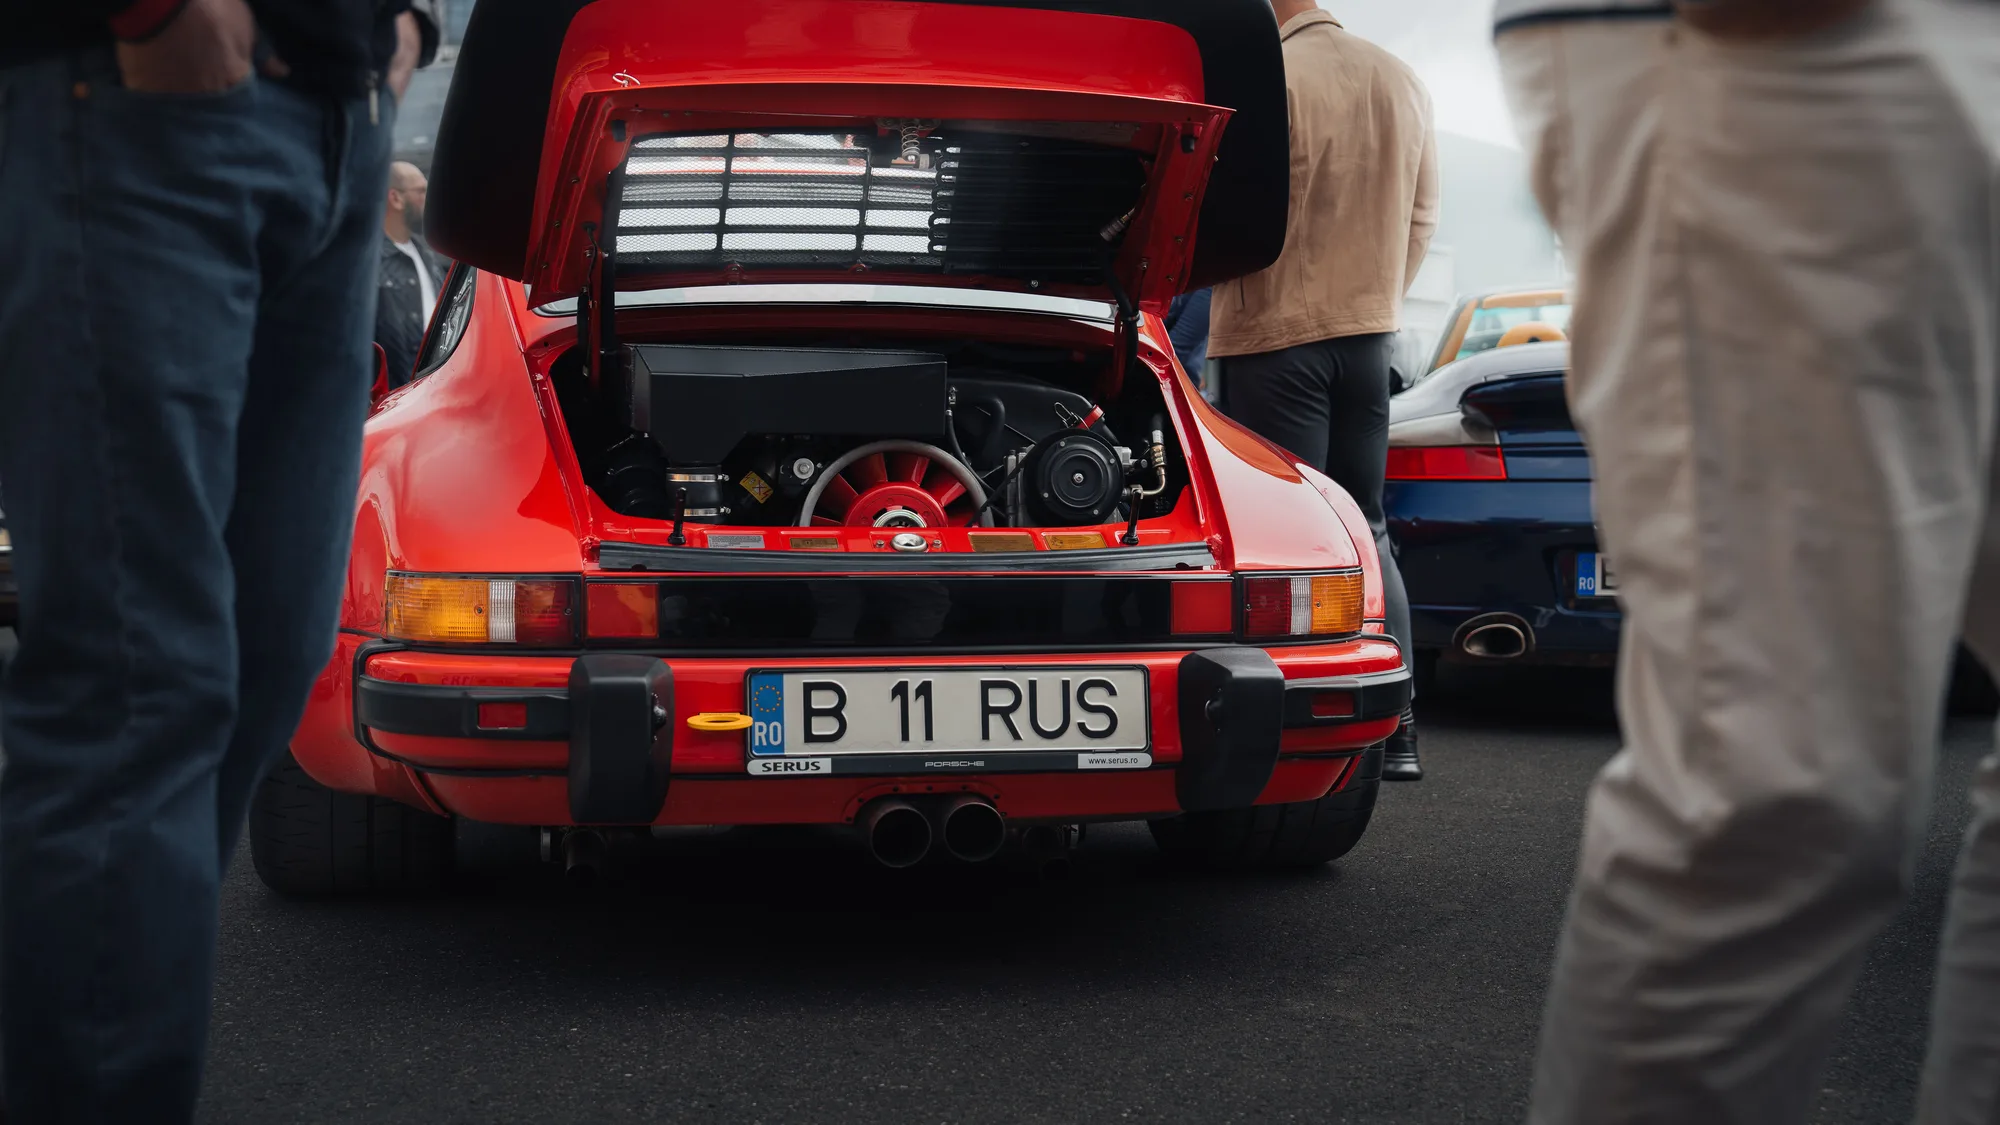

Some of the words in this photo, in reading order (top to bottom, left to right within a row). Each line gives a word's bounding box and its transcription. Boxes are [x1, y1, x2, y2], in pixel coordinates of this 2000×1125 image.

[1579, 577, 1595, 590] RO
[802, 682, 847, 743] B
[891, 681, 933, 741] 11
[981, 679, 1118, 741] RUS
[755, 722, 782, 746] RO
[925, 760, 985, 768] PORSCHE
[1087, 755, 1139, 765] www.serus.ro
[762, 761, 820, 772] SERUS
